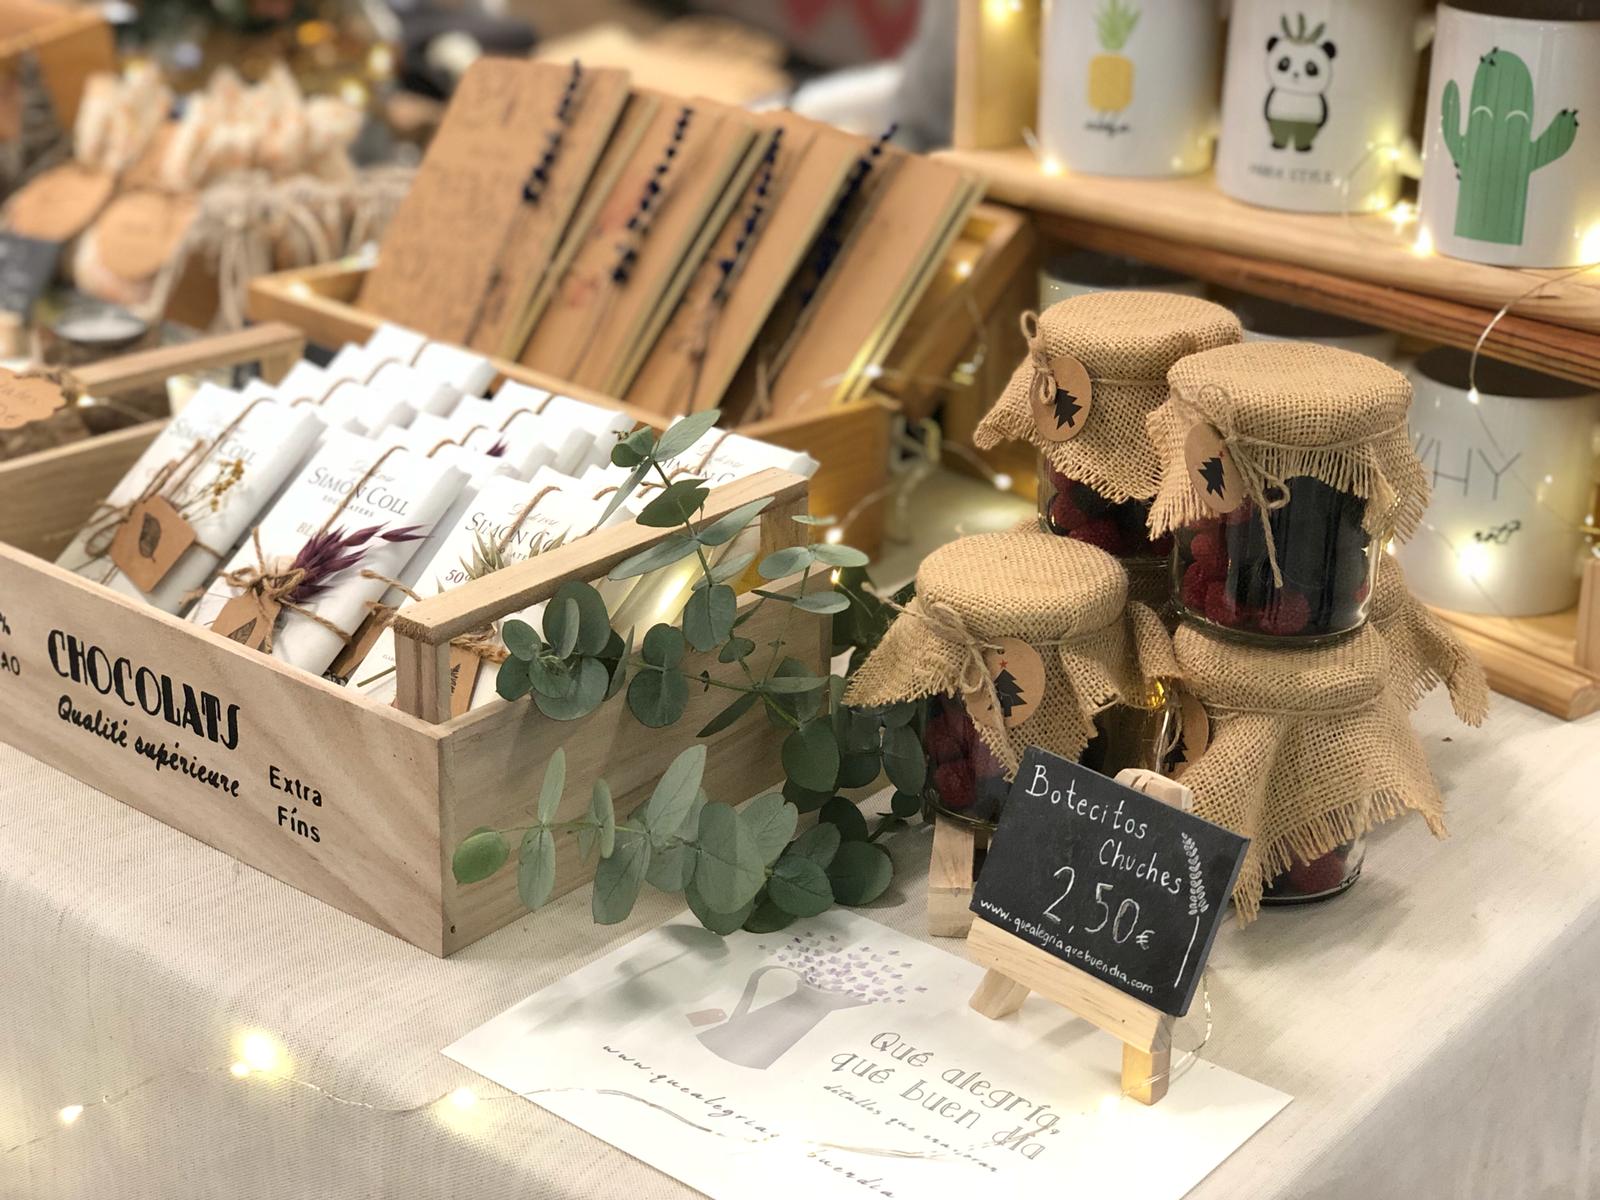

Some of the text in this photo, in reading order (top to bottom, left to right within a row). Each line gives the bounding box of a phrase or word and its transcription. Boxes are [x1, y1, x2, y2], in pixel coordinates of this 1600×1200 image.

[366, 486, 410, 517] COLL
[47, 629, 241, 750] CHOCOLATS
[57, 694, 241, 798] Qualité supérieure
[268, 764, 323, 808] Extra
[1025, 764, 1148, 839] Botecitos
[1099, 838, 1183, 894] Chuches
[870, 1031, 934, 1067] Qué
[823, 1084, 883, 1116] detalles
[884, 1117, 916, 1131] que
[831, 1052, 896, 1085] qué
[899, 1079, 981, 1129] buen
